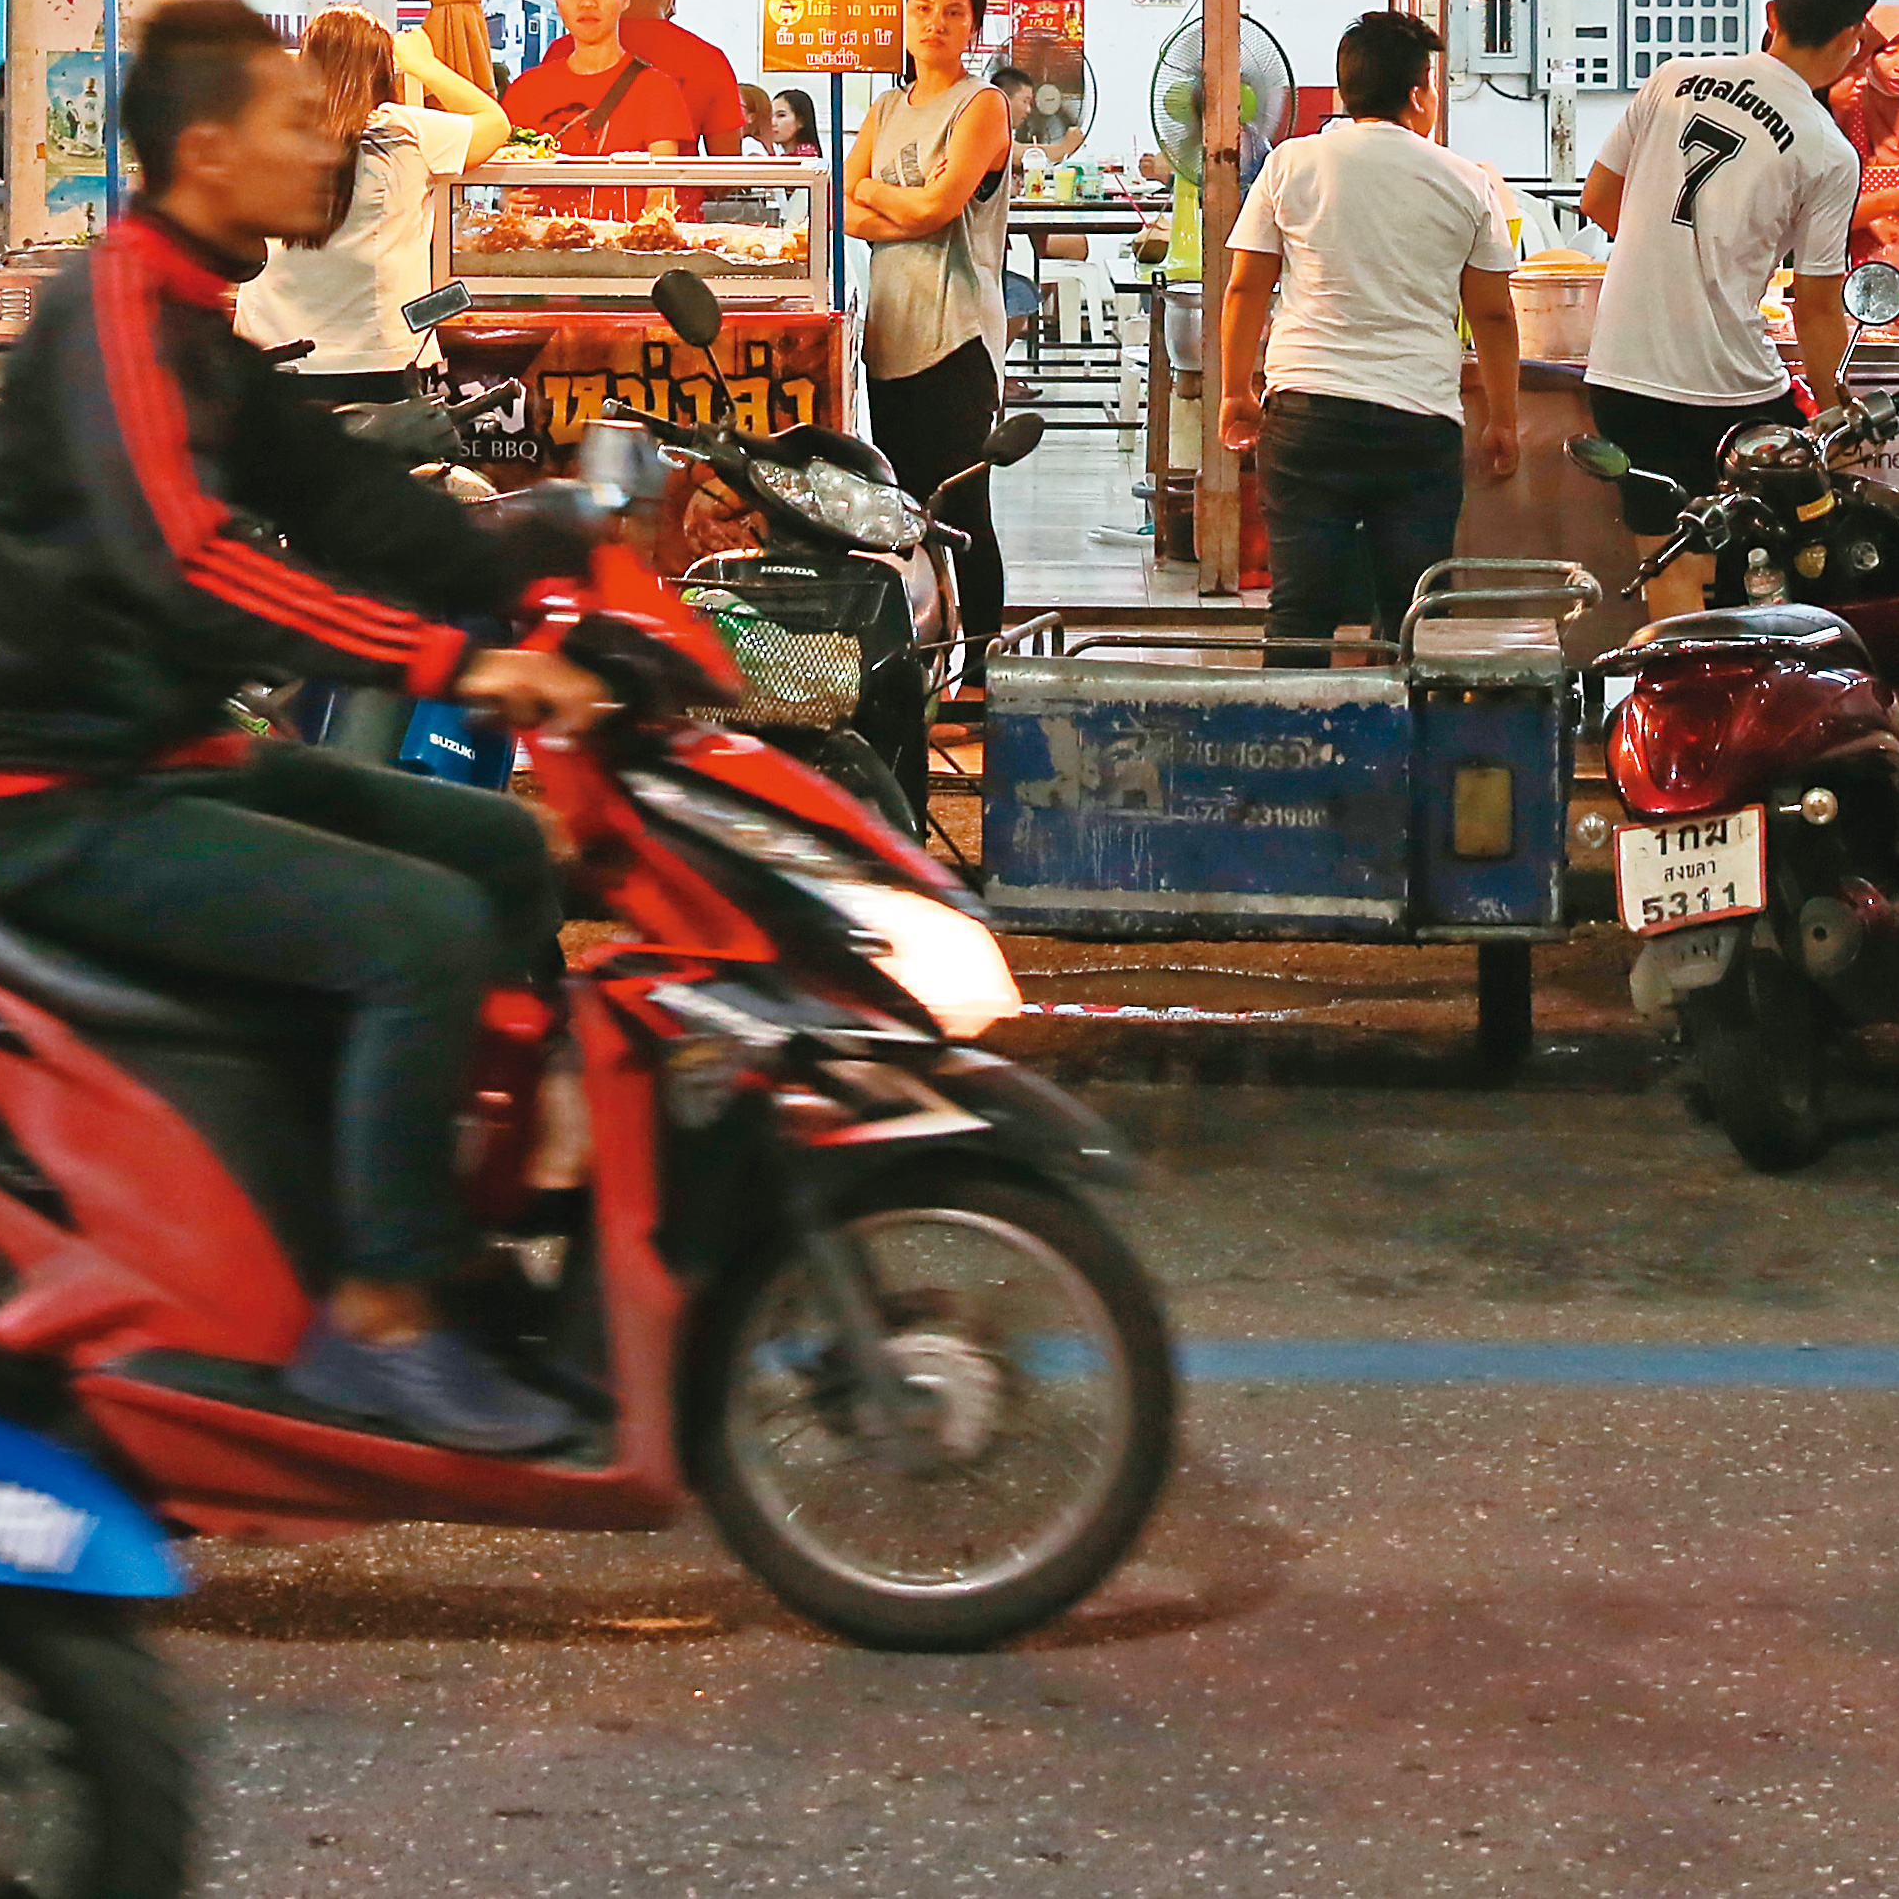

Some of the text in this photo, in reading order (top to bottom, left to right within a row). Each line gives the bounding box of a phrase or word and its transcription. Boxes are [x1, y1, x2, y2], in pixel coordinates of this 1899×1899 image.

[1671, 113, 1747, 228] 7
[492, 440, 538, 462] BBQ
[761, 565, 818, 578] HONDA
[1664, 860, 1717, 882] สงขลา
[1642, 881, 1736, 925] 5311
